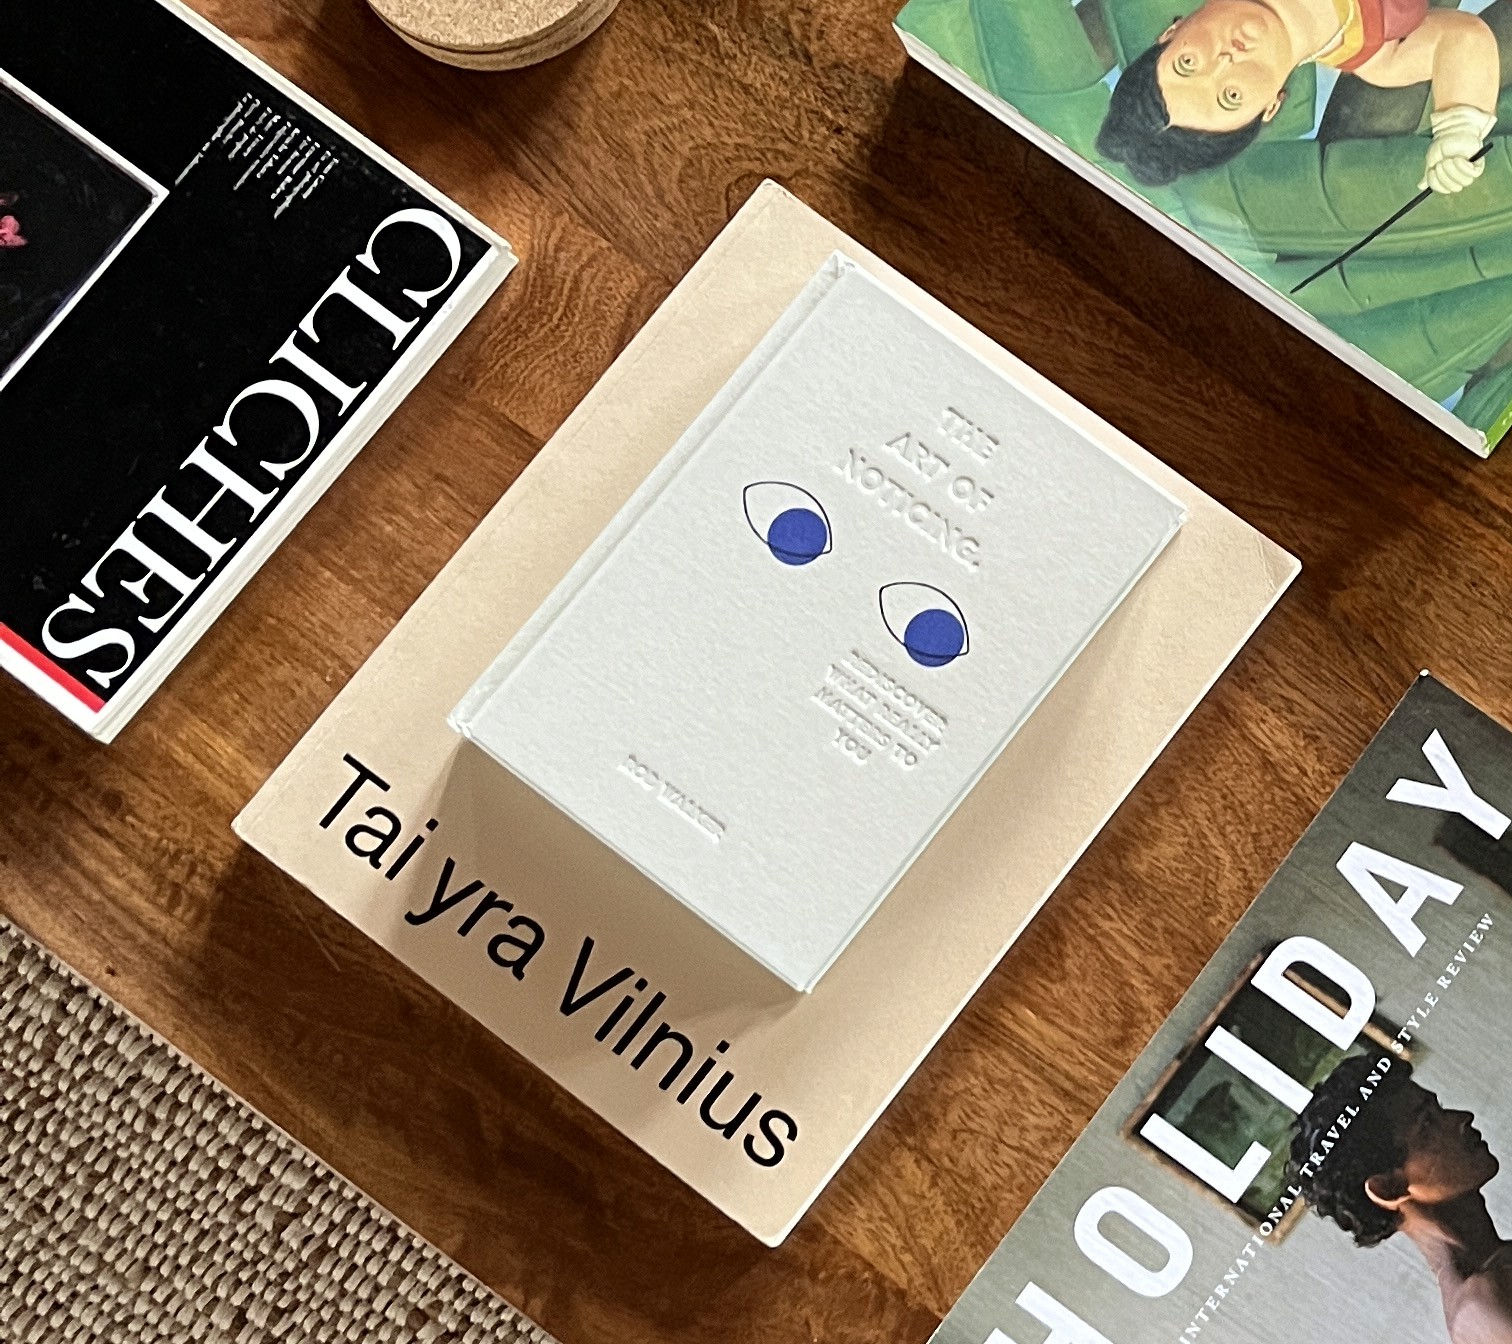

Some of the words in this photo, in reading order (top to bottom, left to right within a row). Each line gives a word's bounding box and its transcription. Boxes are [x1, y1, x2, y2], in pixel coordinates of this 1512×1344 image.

[41, 208, 464, 689] CLICHES
[881, 431, 951, 482] ART
[948, 475, 995, 513] OF
[937, 406, 1000, 465] THE
[891, 742, 918, 771] TO
[319, 752, 439, 881] Tai
[404, 856, 546, 981] yra
[560, 935, 798, 1168] Vilnius
[1299, 1099, 1360, 1181] TRAVEL
[1353, 1055, 1393, 1103] AND
[1389, 991, 1440, 1055] STYLE
[1435, 912, 1494, 994] REVIEW
